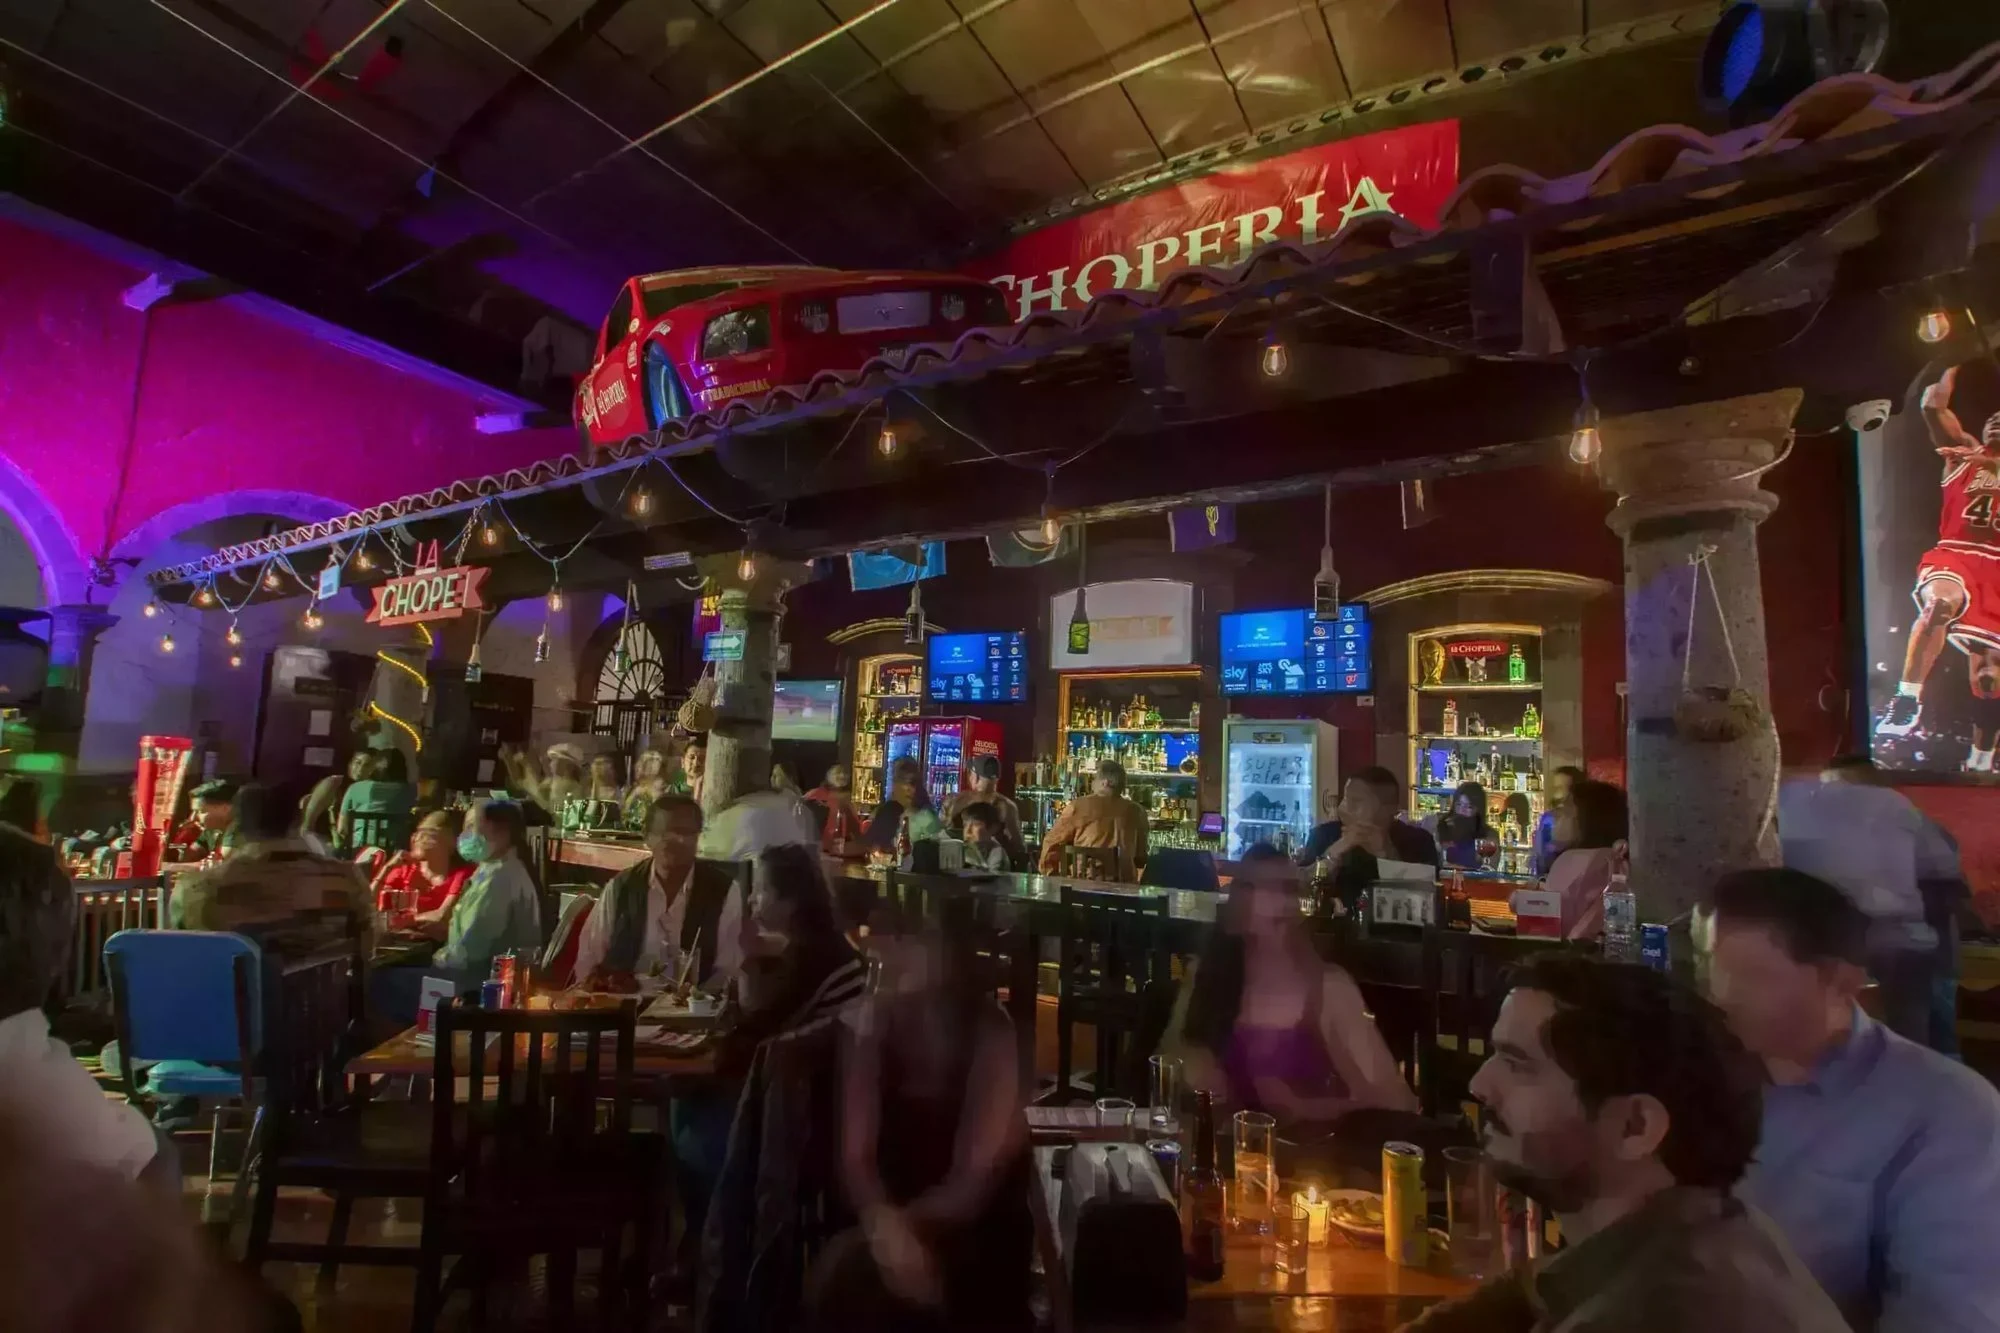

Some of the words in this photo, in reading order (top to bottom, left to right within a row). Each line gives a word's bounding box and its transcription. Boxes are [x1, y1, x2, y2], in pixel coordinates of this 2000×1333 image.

[416, 539, 438, 569] LA
[381, 573, 459, 617] CHOPE
[1459, 644, 1502, 653] CHOPERIA
[1225, 666, 1248, 681] sky
[931, 678, 947, 690] sky
[1245, 756, 1303, 771] SUPER
